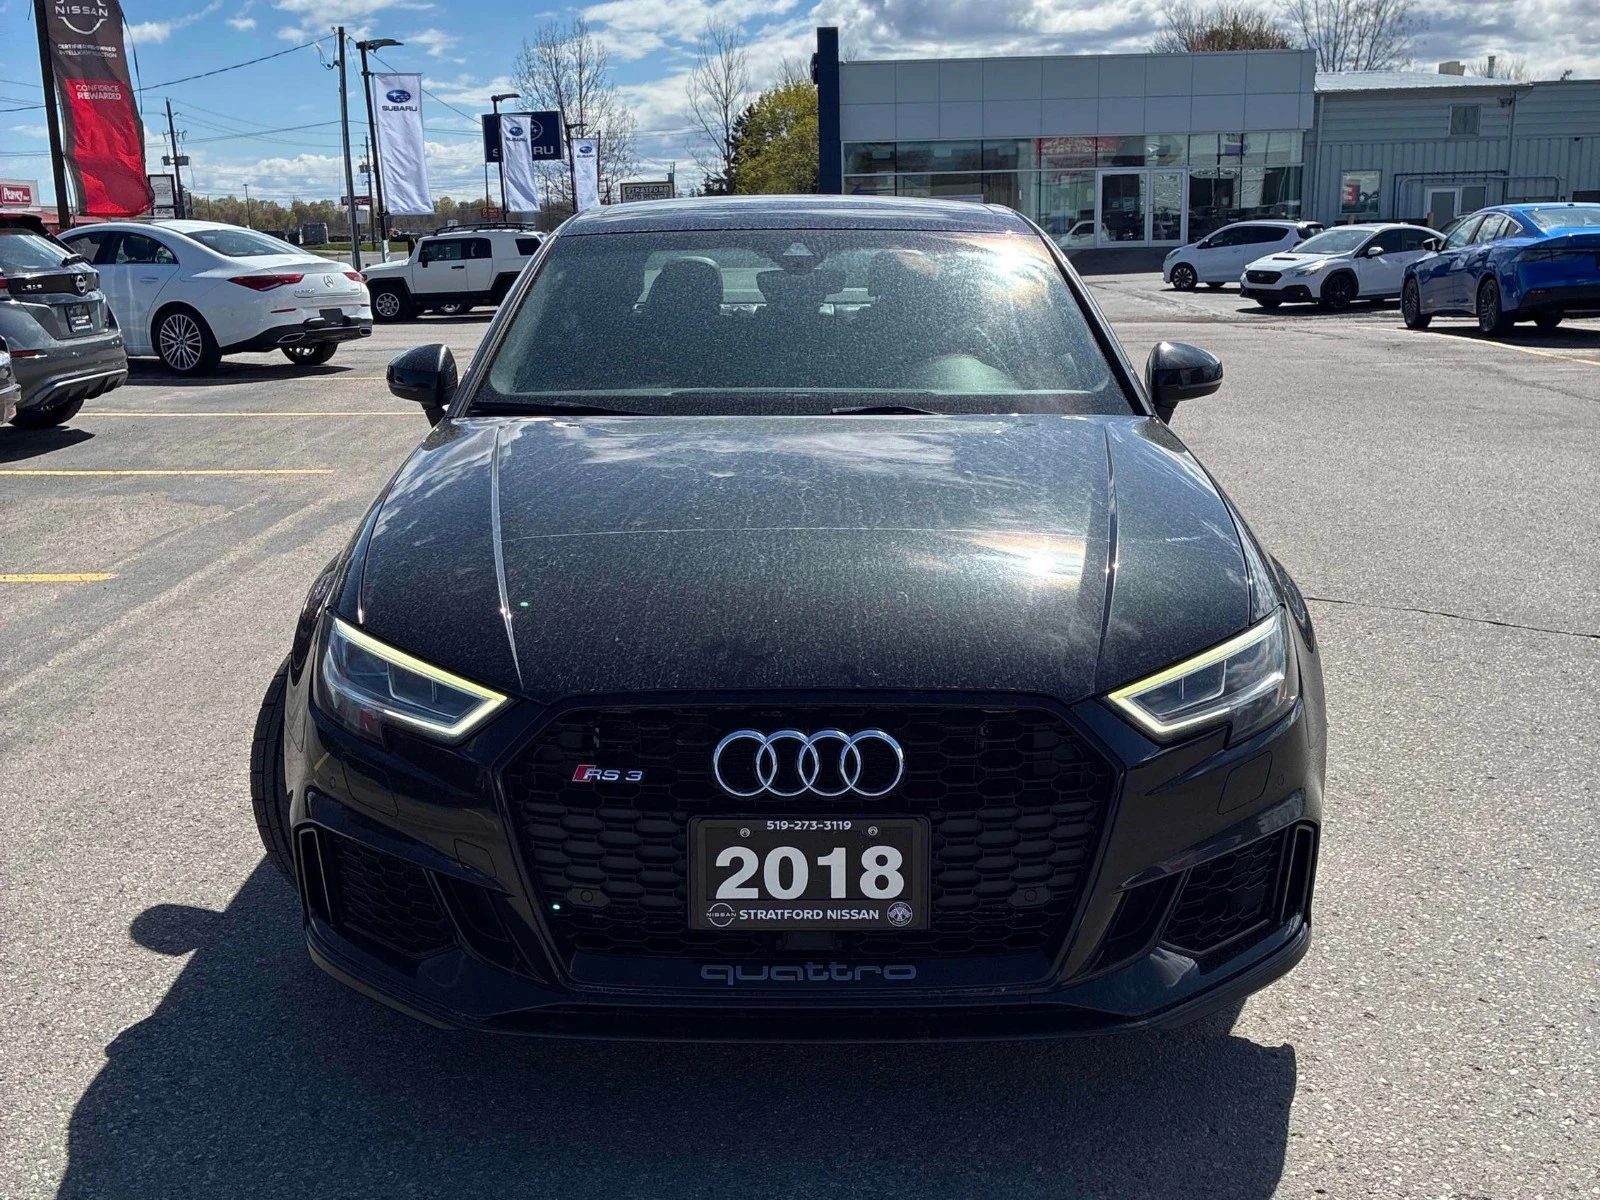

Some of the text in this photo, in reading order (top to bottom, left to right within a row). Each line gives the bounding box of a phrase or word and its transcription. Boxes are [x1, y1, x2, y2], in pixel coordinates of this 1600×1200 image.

[55, 6, 108, 17] NISSAN
[75, 84, 120, 92] CONFIDENCE
[76, 92, 122, 100] REWARDED
[582, 768, 643, 781] RS 3
[766, 820, 852, 831] 519-273-3119
[715, 845, 905, 900] 2018
[739, 909, 880, 920] STRATFORD NISSAN
[700, 961, 917, 986] quattro
